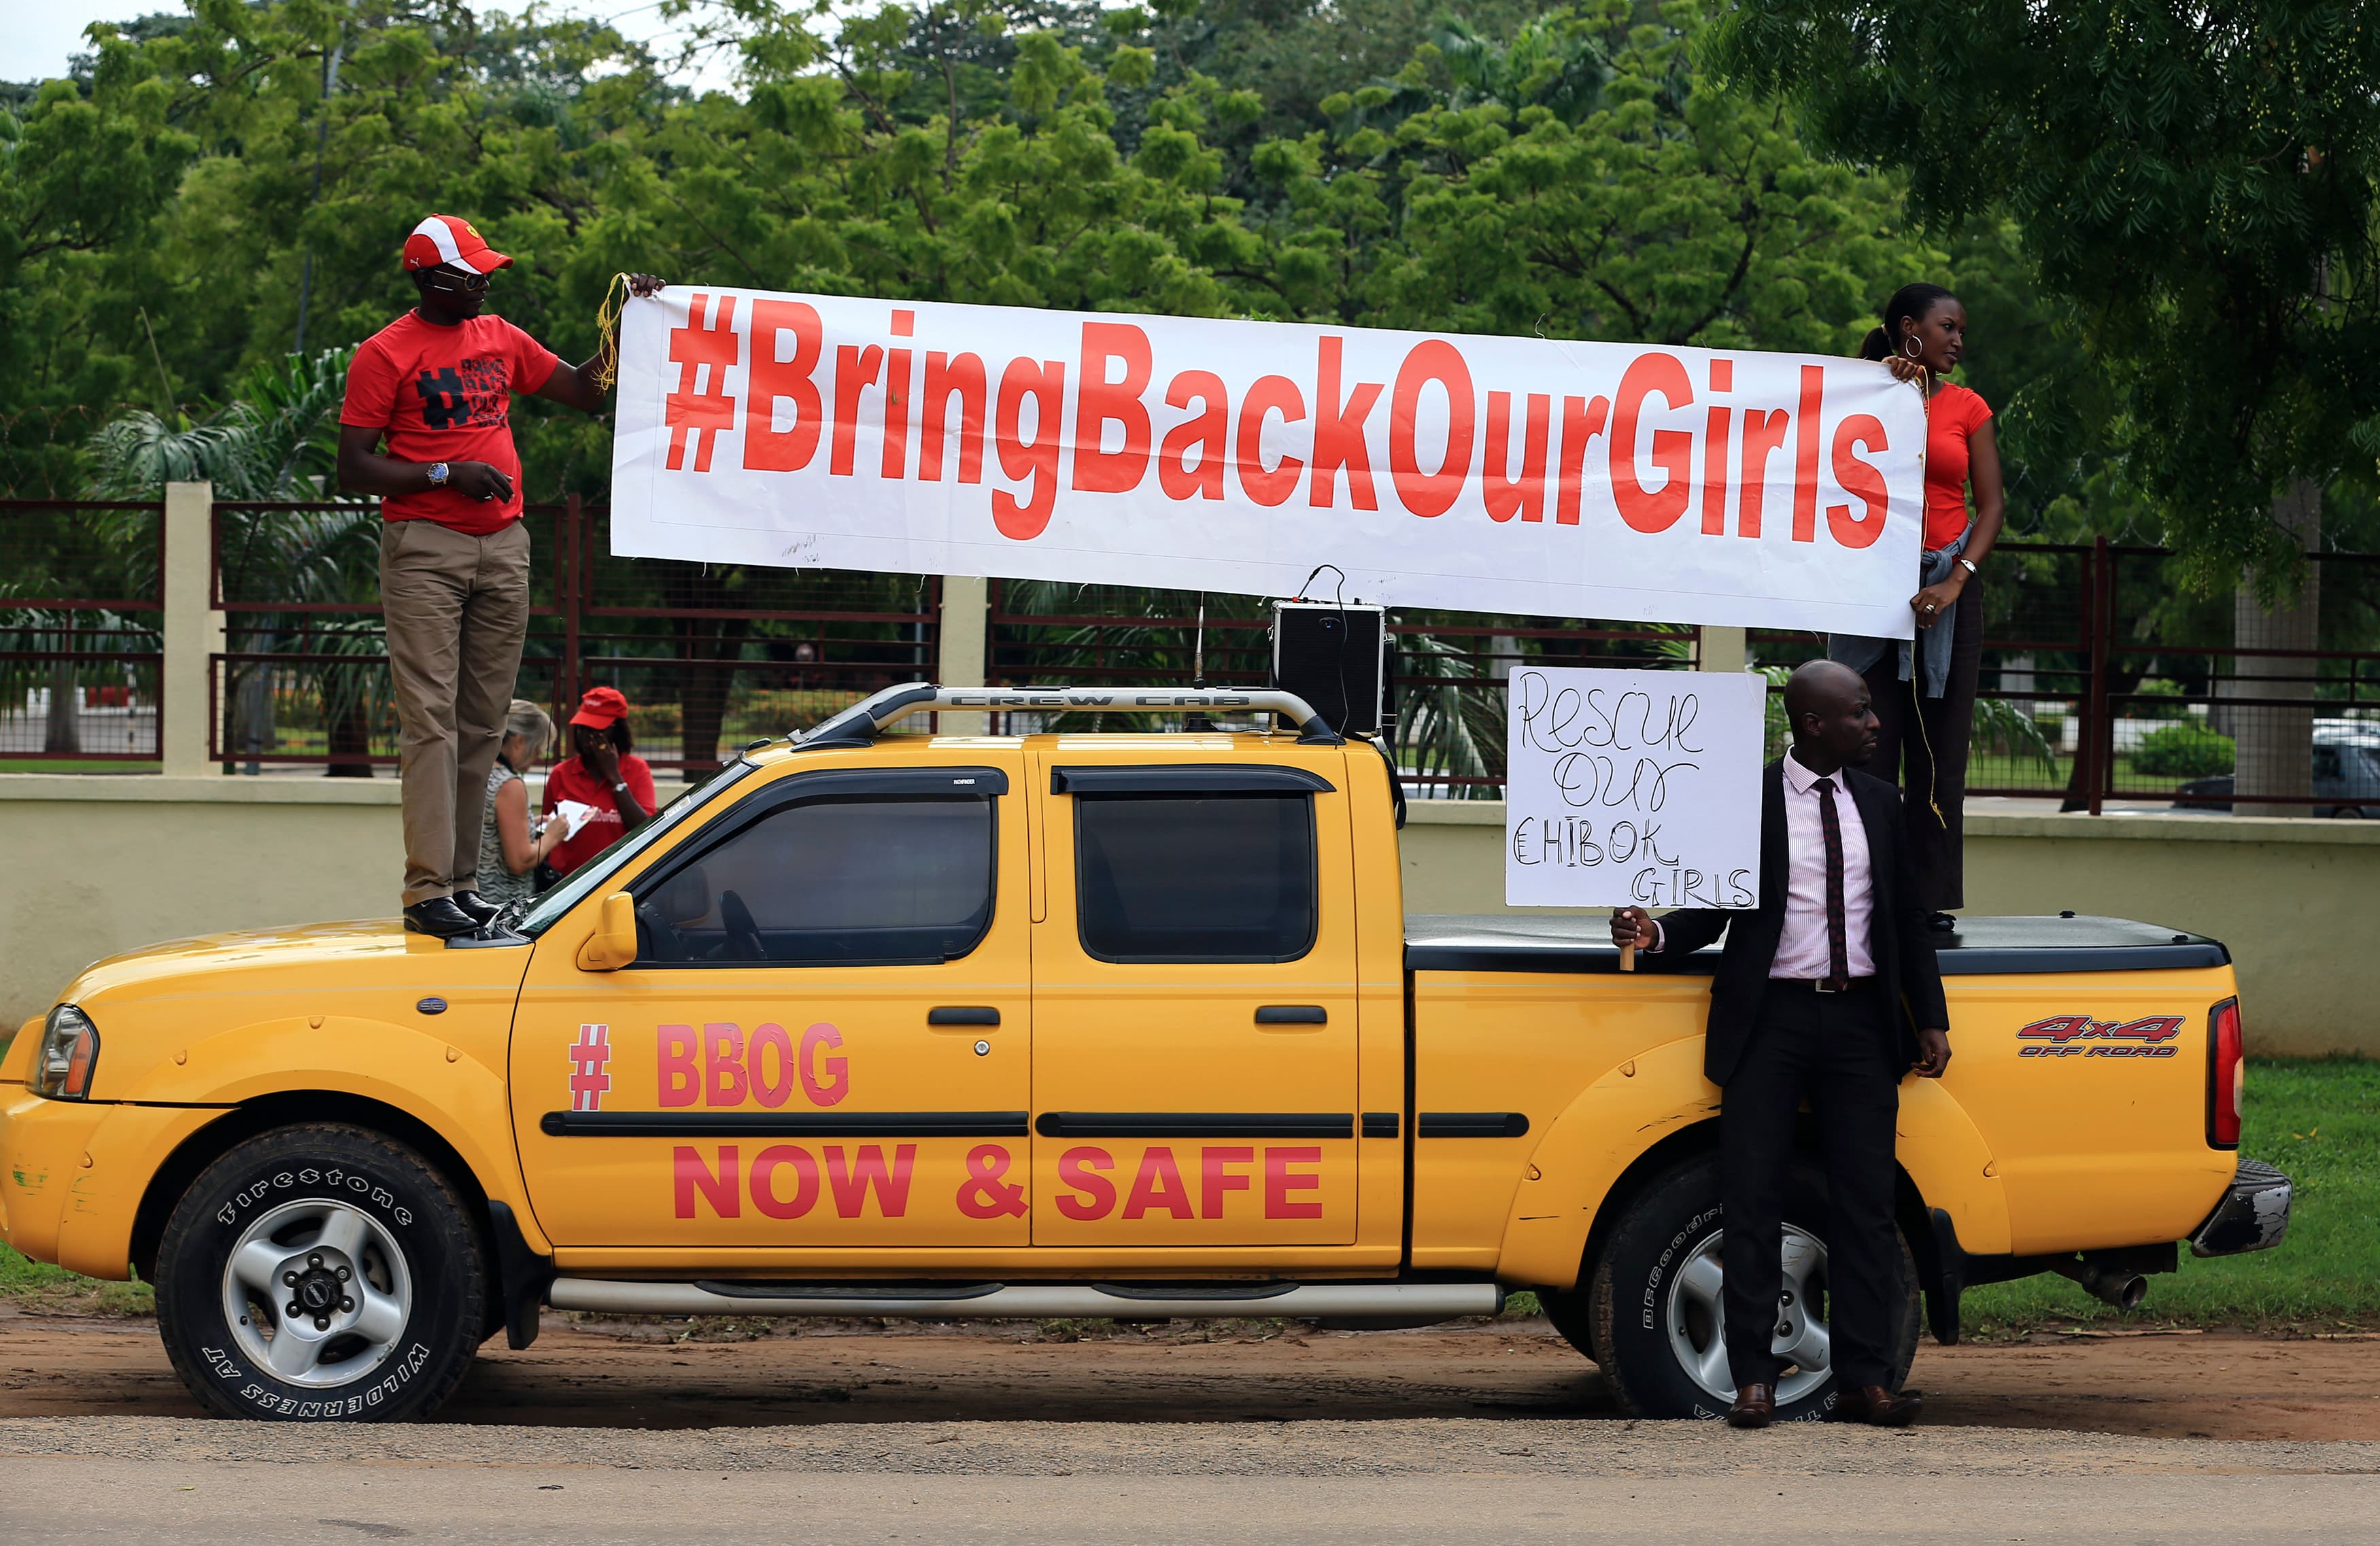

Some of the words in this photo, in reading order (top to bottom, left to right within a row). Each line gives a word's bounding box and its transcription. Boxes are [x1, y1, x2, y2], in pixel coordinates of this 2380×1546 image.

[666, 294, 1889, 549] #BringBackOurGirls
[951, 696, 1113, 706] CREW
[1136, 696, 1250, 706] CAB
[1631, 868, 1755, 908] GIRLS
[2016, 1015, 2186, 1044] 4x4
[2018, 1046, 2086, 1057] OFF
[2084, 1046, 2179, 1058] ROAD
[568, 1024, 611, 1112] #
[657, 1023, 849, 1109] BBOG
[217, 1168, 413, 1226] Firestone
[673, 1144, 917, 1220] NOW
[955, 1144, 1030, 1220] &
[1055, 1146, 1323, 1222] SAFE
[1643, 1203, 1723, 1329] BFGoodri
[202, 1347, 241, 1378] AT
[241, 1343, 430, 1417] WILDERNESS
